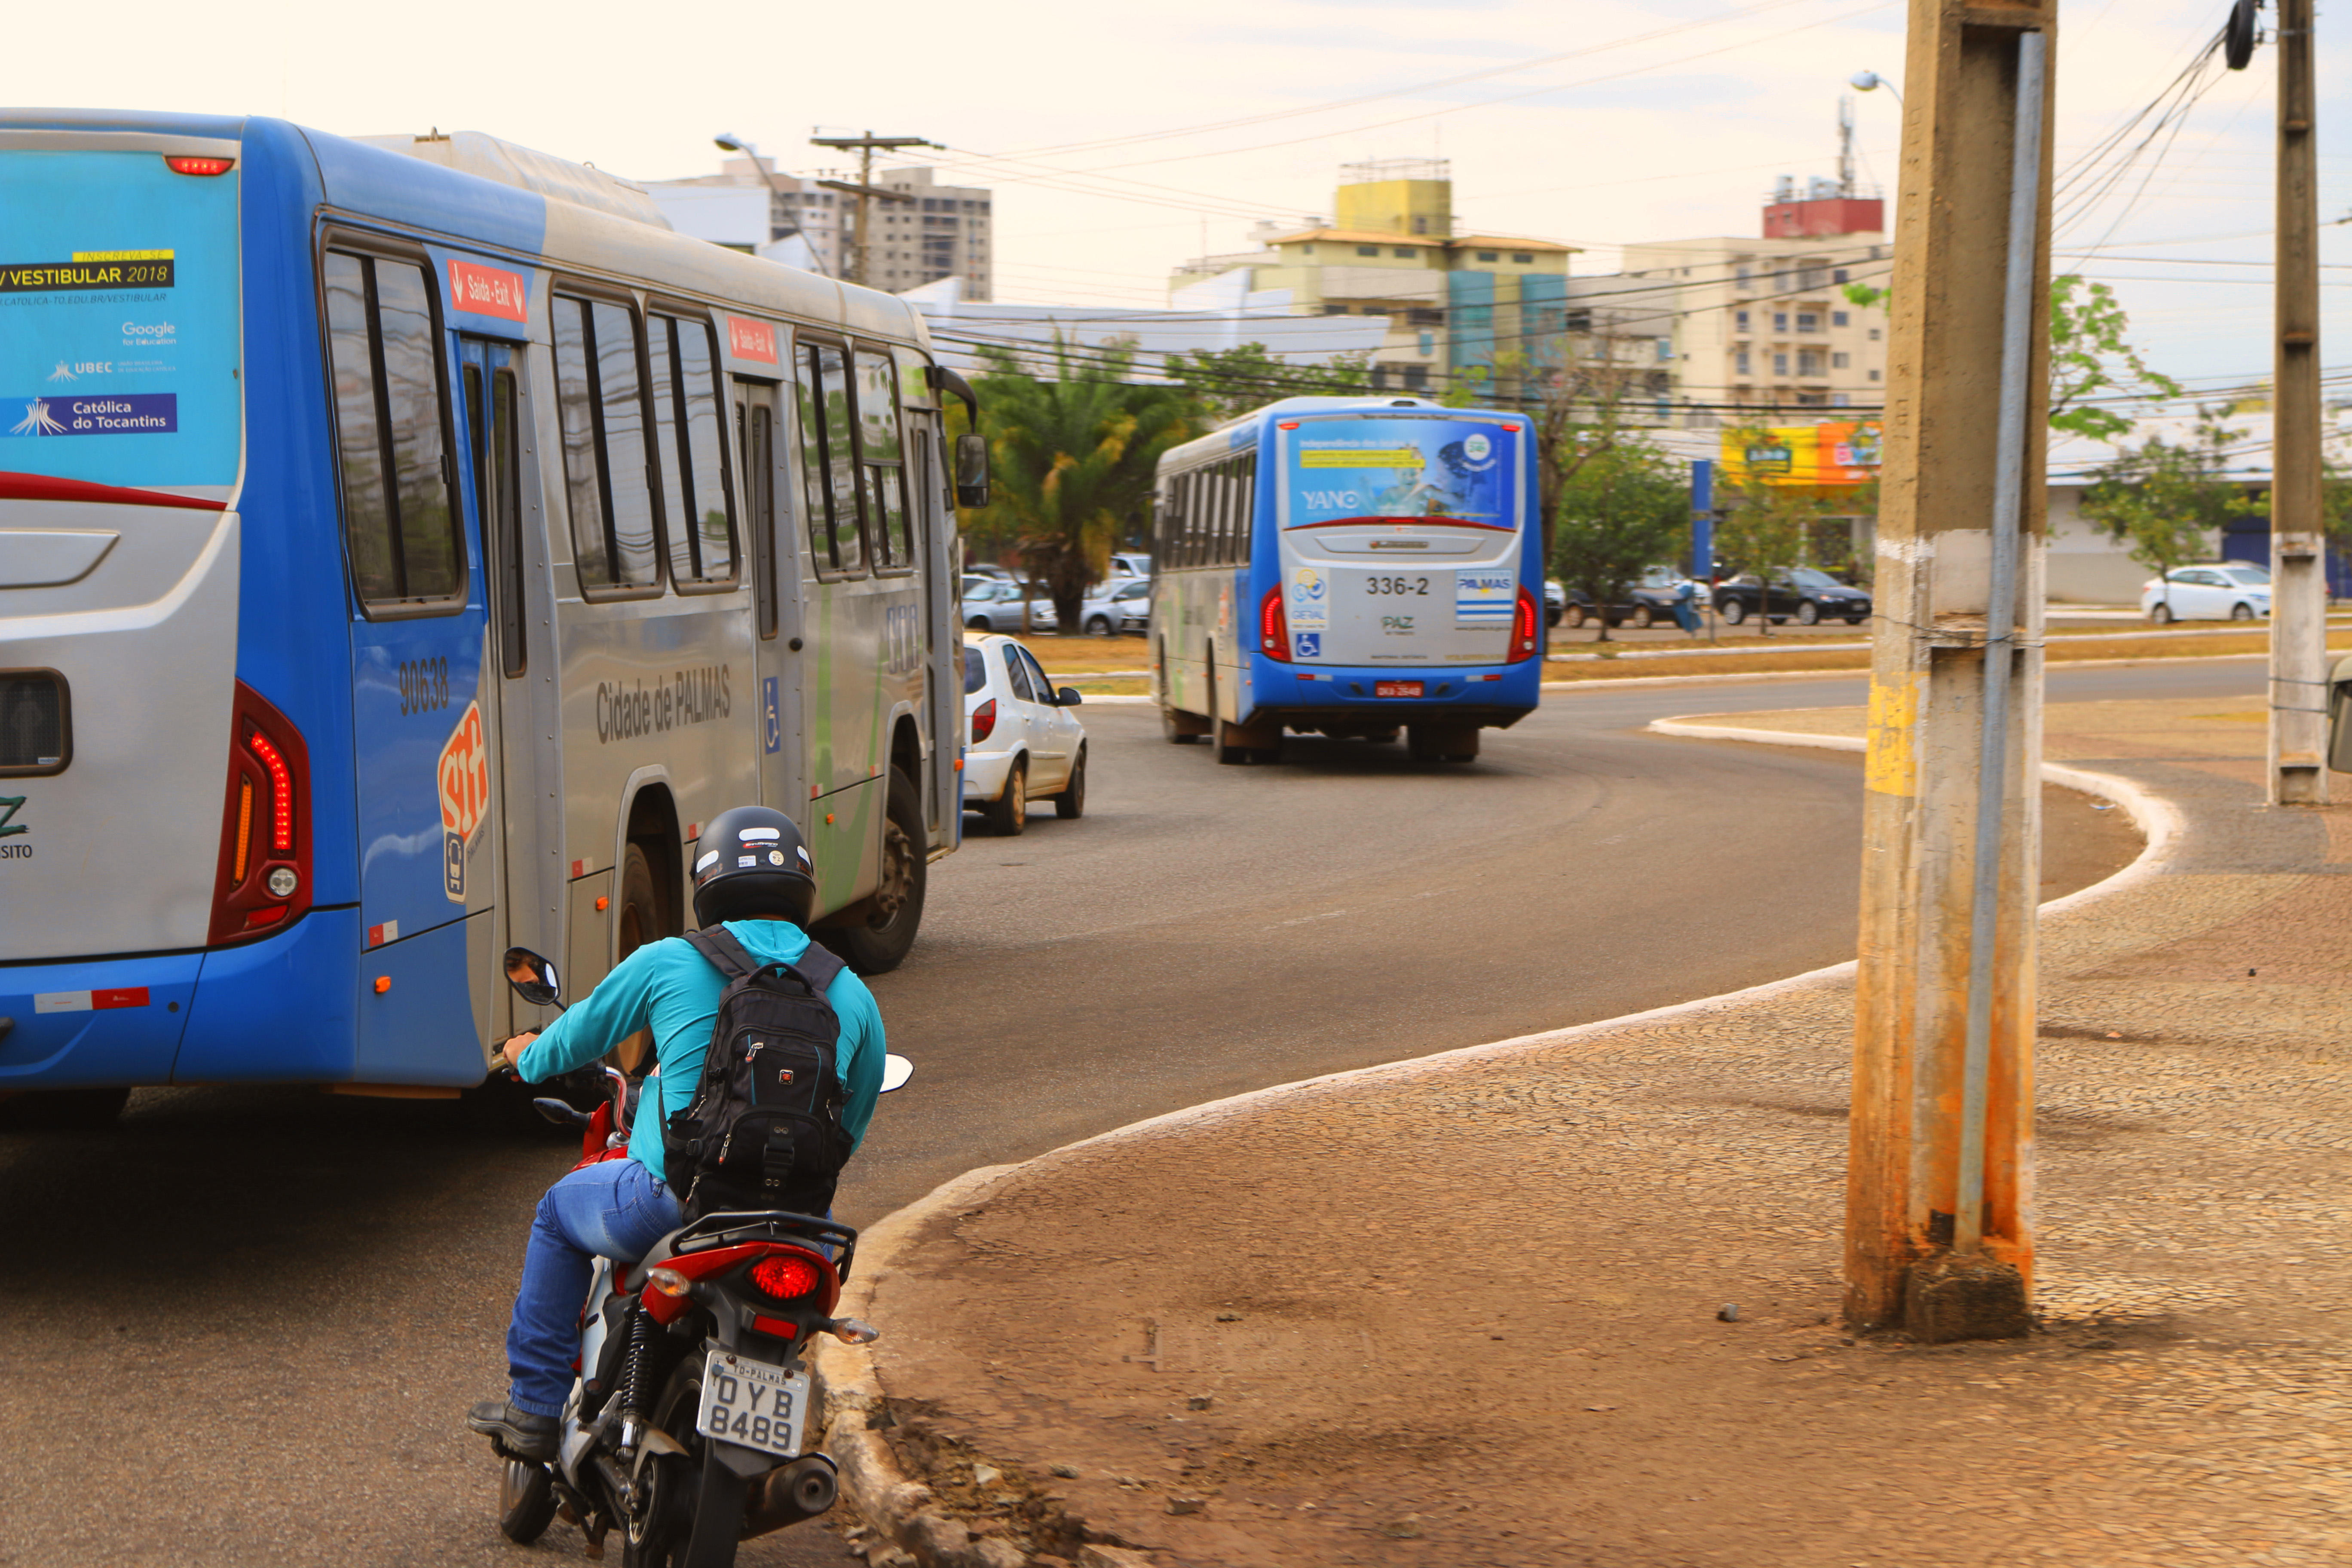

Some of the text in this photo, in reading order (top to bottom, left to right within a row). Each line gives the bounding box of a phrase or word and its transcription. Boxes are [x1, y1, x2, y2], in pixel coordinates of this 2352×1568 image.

[83, 251, 164, 263] INSCREVA-SE
[9, 266, 122, 285] VESTIBULAR
[127, 266, 167, 282] 2018
[468, 274, 490, 302] Saída
[494, 280, 510, 307] Exit
[122, 322, 175, 337] Google
[75, 362, 113, 374] UBEC
[73, 401, 132, 414] Católica
[73, 415, 166, 429] do Tocantins
[1366, 577, 1429, 595] 336-2
[1458, 579, 1511, 589] PALMAS
[1381, 616, 1414, 630] PAZ
[399, 655, 449, 717] 90638
[597, 664, 730, 745] Cidade de PALMAS
[0, 844, 33, 858] SITO
[717, 1375, 793, 1418] OYB
[710, 1405, 792, 1451] 8489
